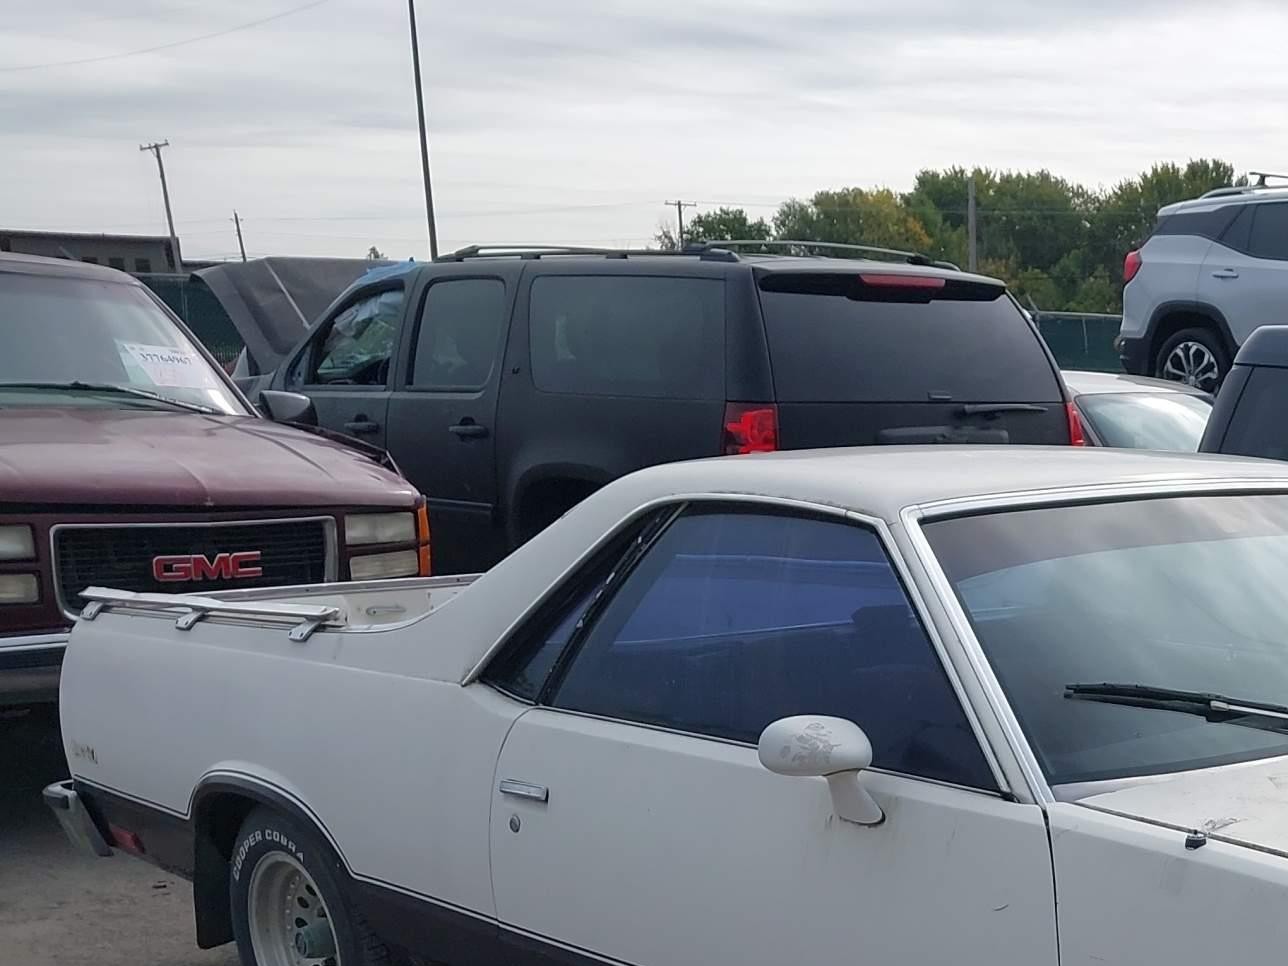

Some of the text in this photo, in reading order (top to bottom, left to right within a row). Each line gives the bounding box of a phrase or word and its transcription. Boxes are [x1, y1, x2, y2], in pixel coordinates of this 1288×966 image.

[153, 551, 262, 582] GMC
[233, 829, 304, 881] COOPER COBRA
